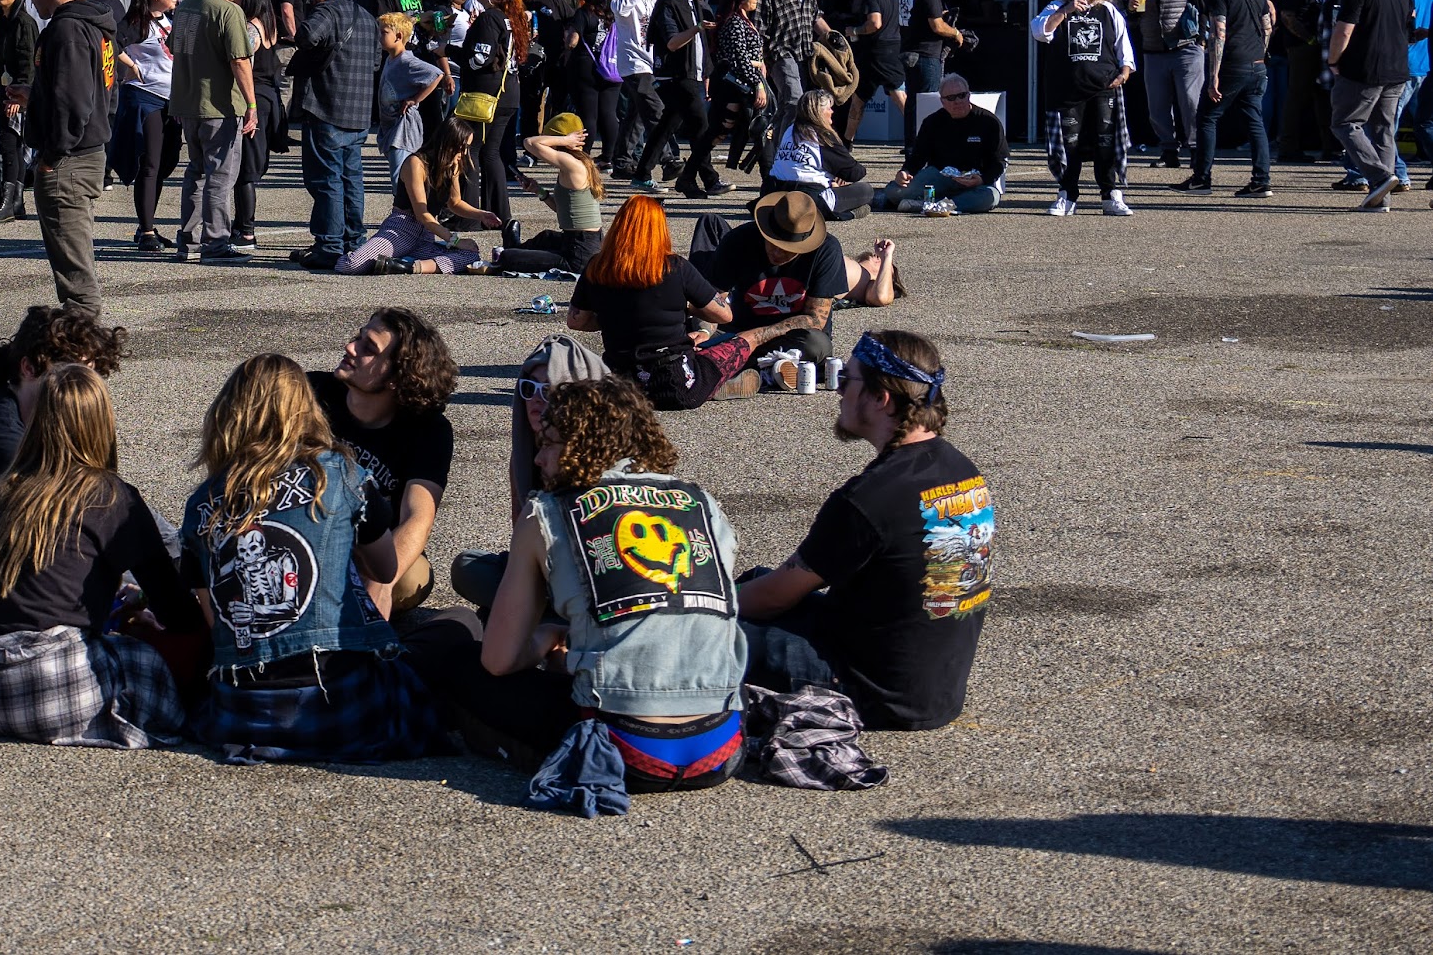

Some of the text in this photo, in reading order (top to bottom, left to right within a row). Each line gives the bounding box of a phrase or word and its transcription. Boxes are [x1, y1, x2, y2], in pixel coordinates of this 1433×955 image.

[575, 484, 698, 525] DRIP
[933, 492, 974, 520] YUBA
[597, 595, 667, 615] ALL DAY
[236, 629, 248, 637] 30
